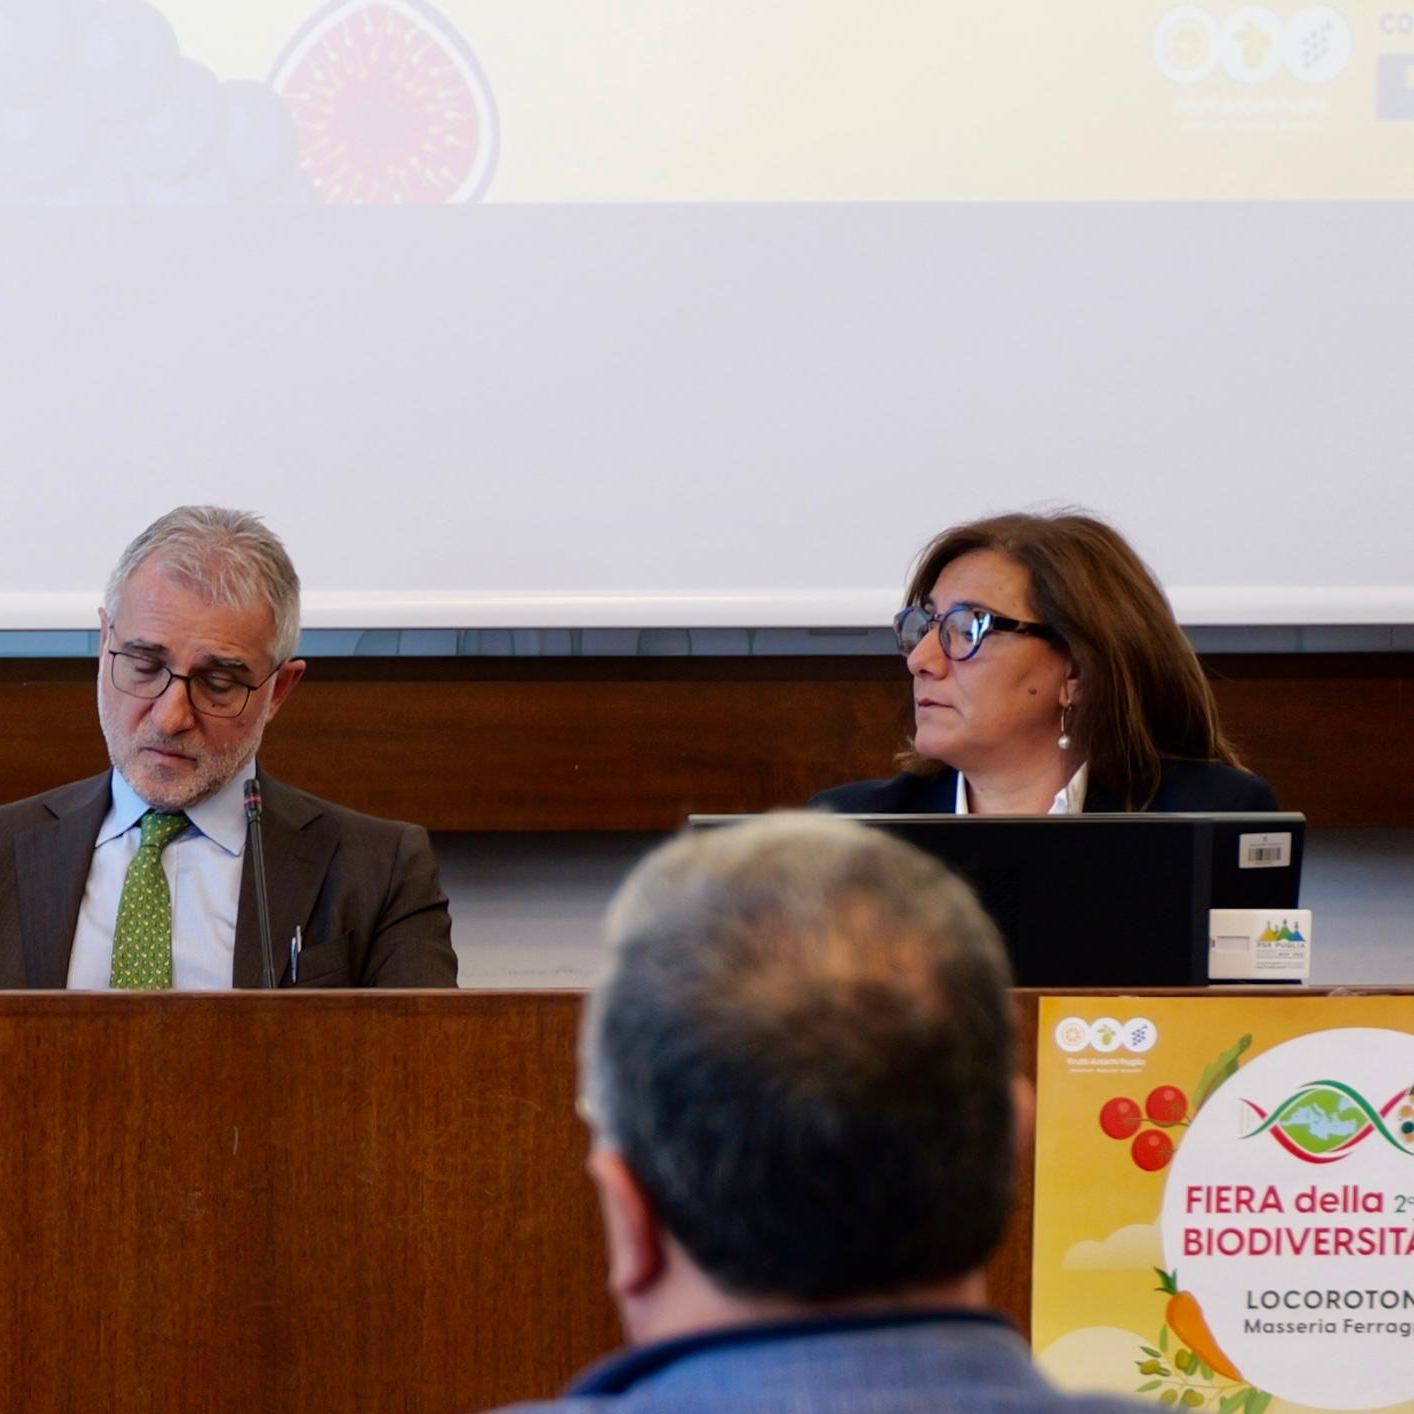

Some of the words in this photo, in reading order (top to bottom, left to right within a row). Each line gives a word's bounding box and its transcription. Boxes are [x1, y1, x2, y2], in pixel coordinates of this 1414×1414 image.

[1186, 1186, 1284, 1214] FIERA
[1294, 1185, 1384, 1213] della
[1245, 1319, 1336, 1334] Masseria
